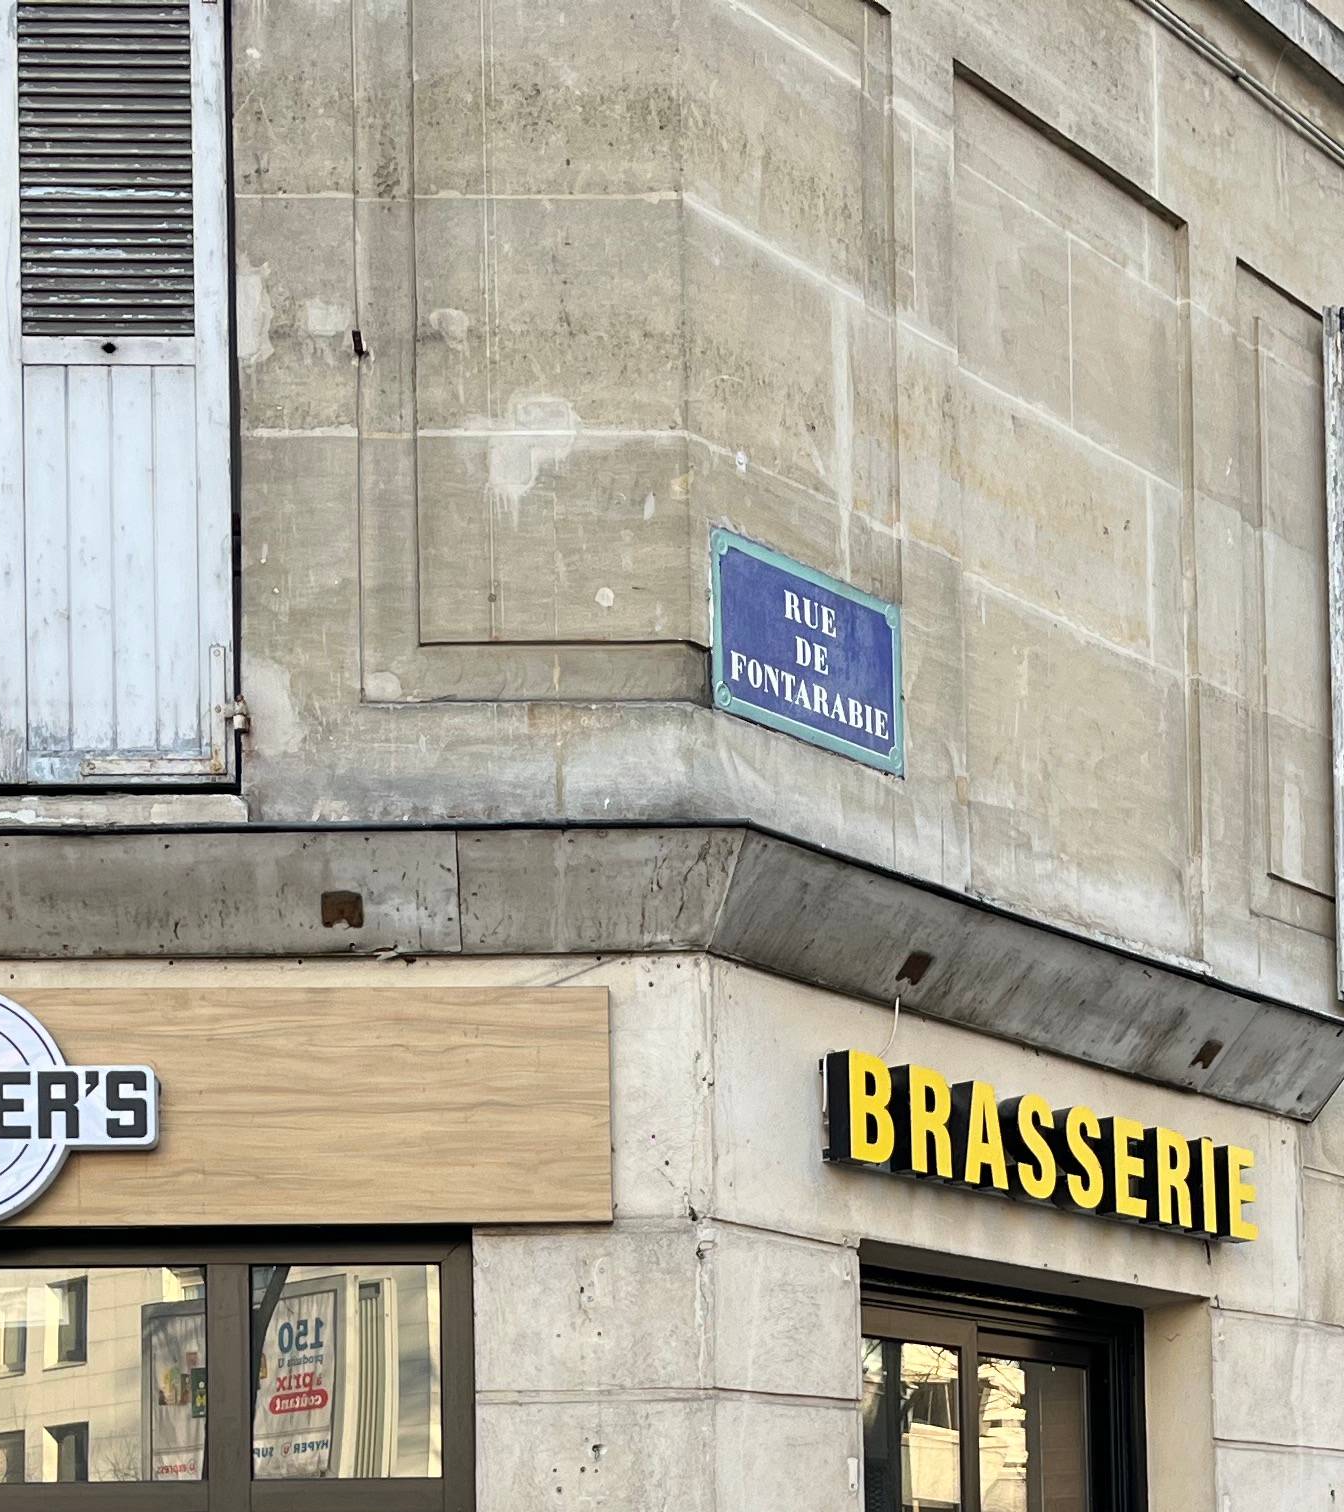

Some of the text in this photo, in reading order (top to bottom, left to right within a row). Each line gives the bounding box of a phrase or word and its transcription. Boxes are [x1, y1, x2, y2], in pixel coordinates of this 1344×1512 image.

[784, 589, 837, 638] RUE
[795, 635, 829, 675] DE
[730, 650, 889, 740] FONTARABIE
[848, 1048, 1260, 1242] BRASSERIE
